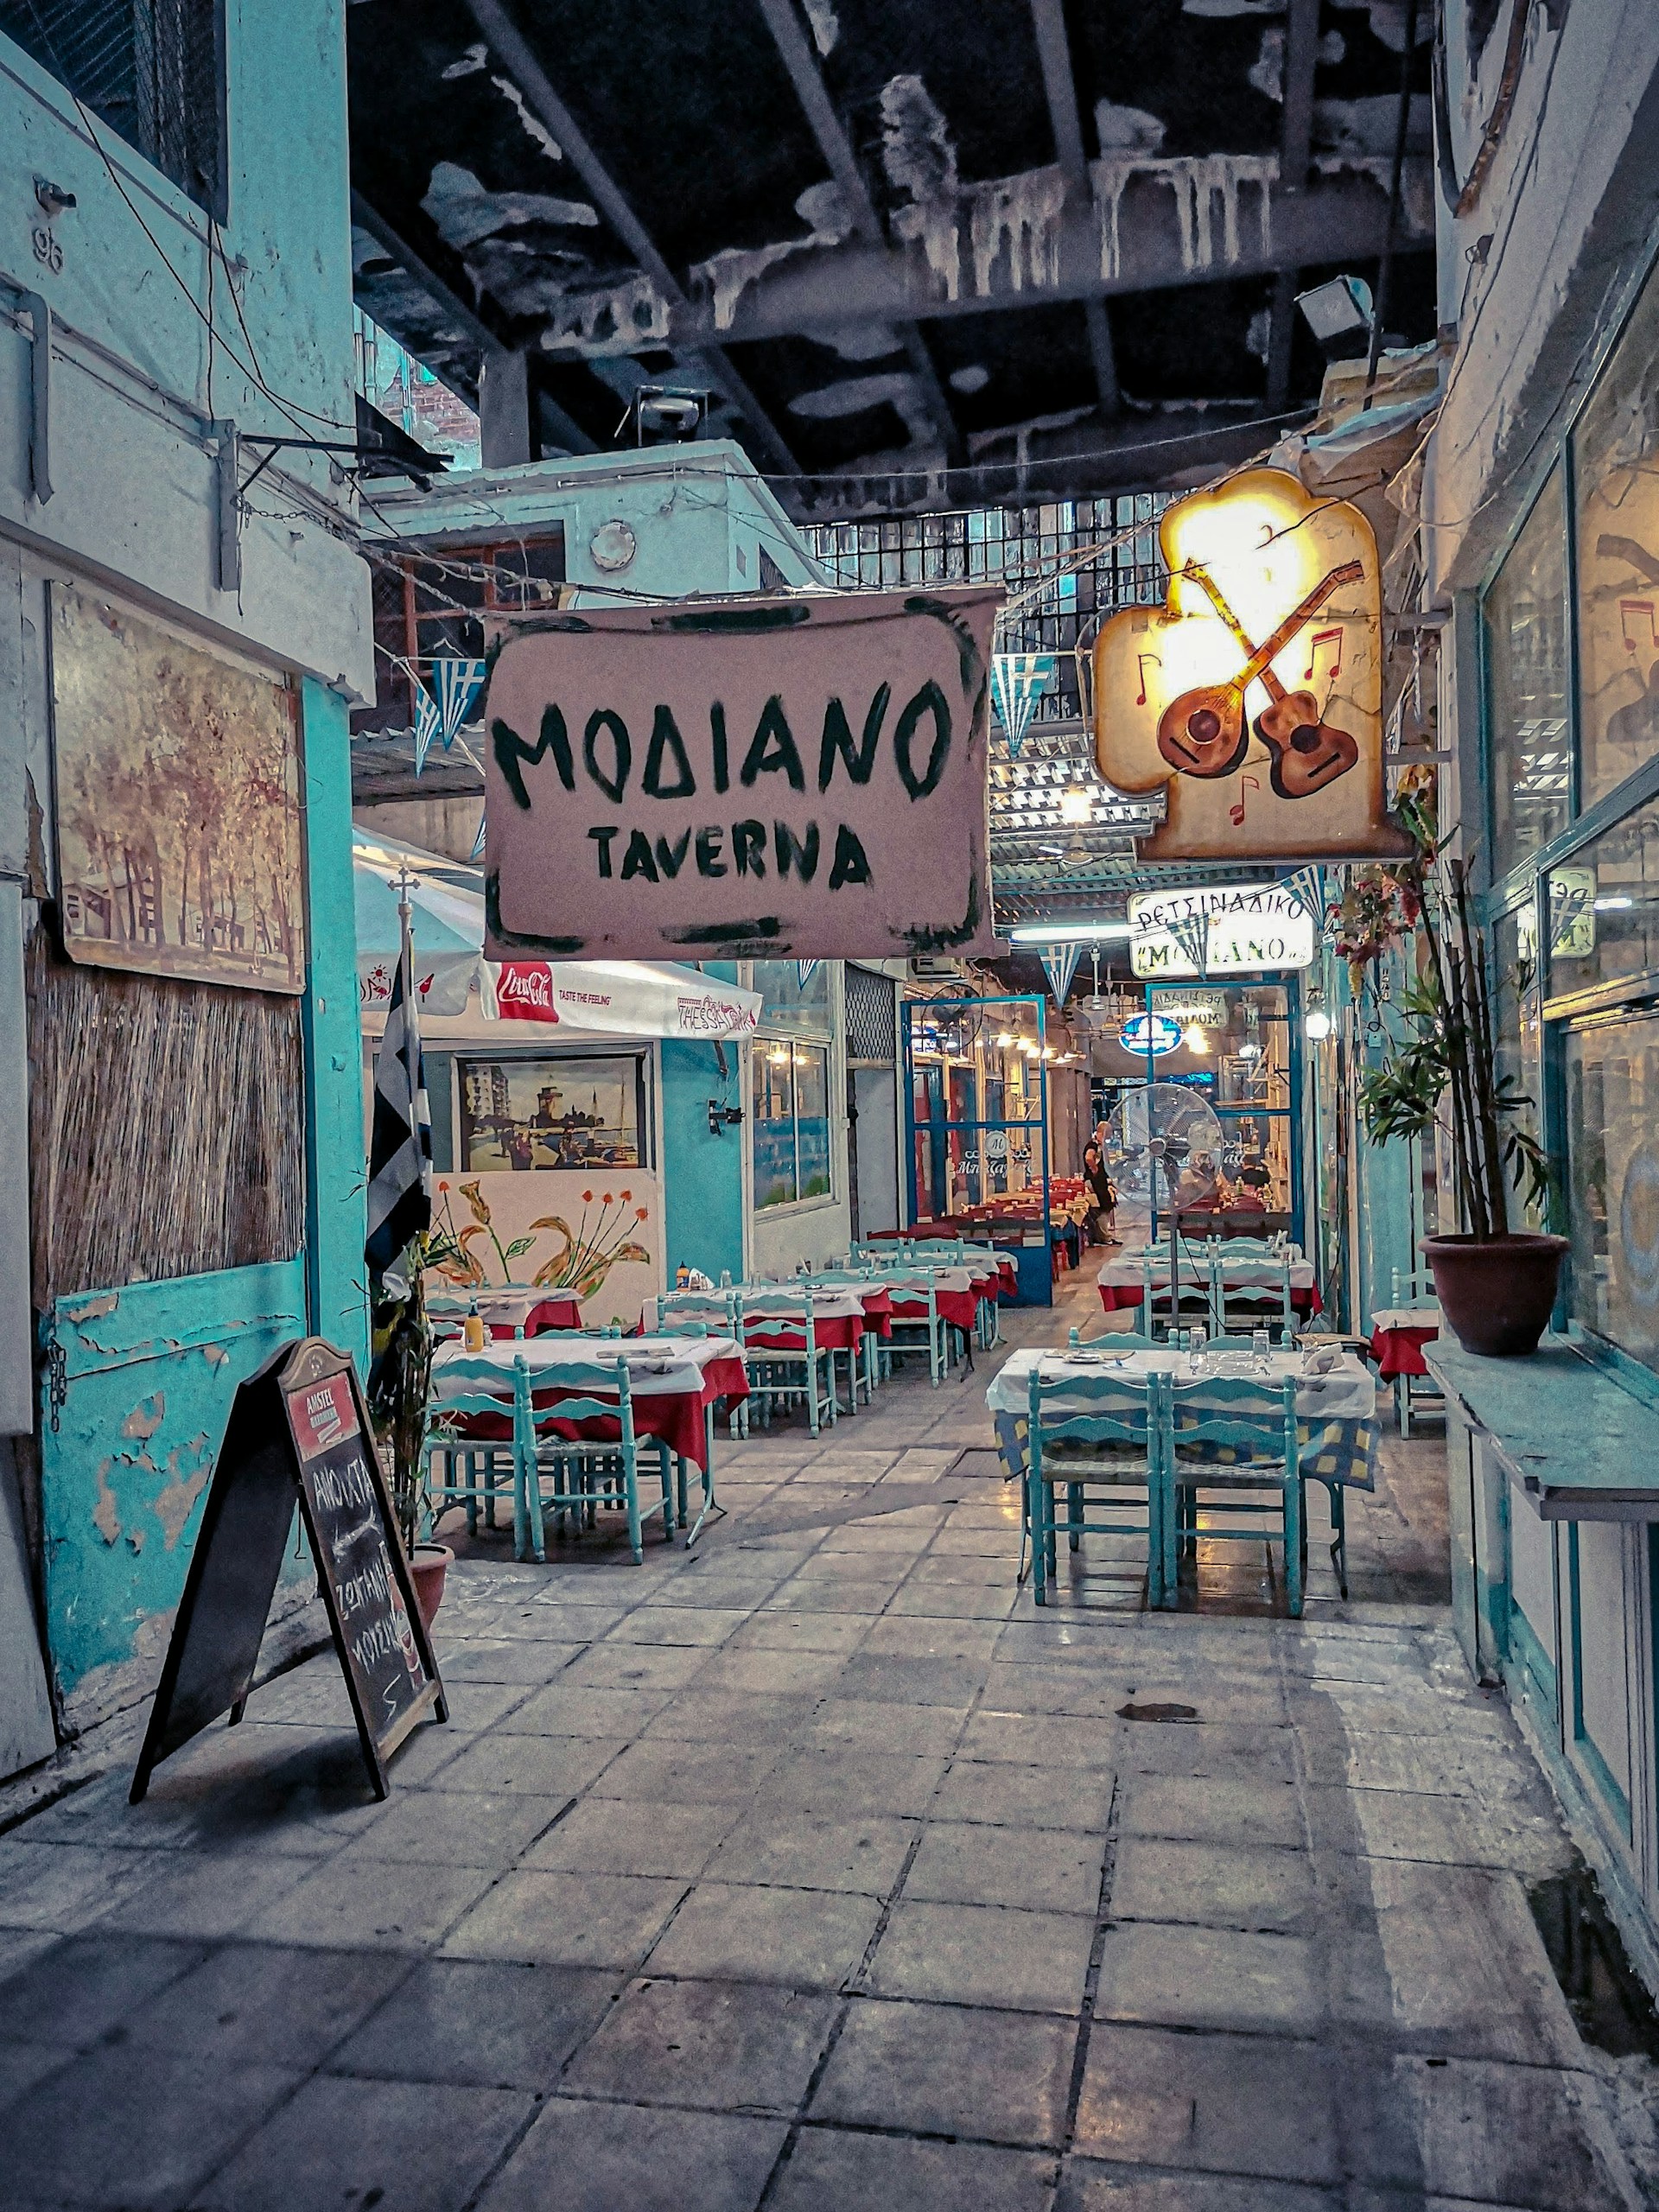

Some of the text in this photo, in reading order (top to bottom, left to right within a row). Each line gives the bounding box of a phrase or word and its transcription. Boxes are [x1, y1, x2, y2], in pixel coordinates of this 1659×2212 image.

[492, 679, 951, 809] ΜΟΔΙΑΝΟ
[587, 819, 873, 890] TAVERNA
[558, 989, 577, 1002] TASTE
[576, 992, 588, 1003] THE
[306, 1387, 335, 1415] AMSTEL
